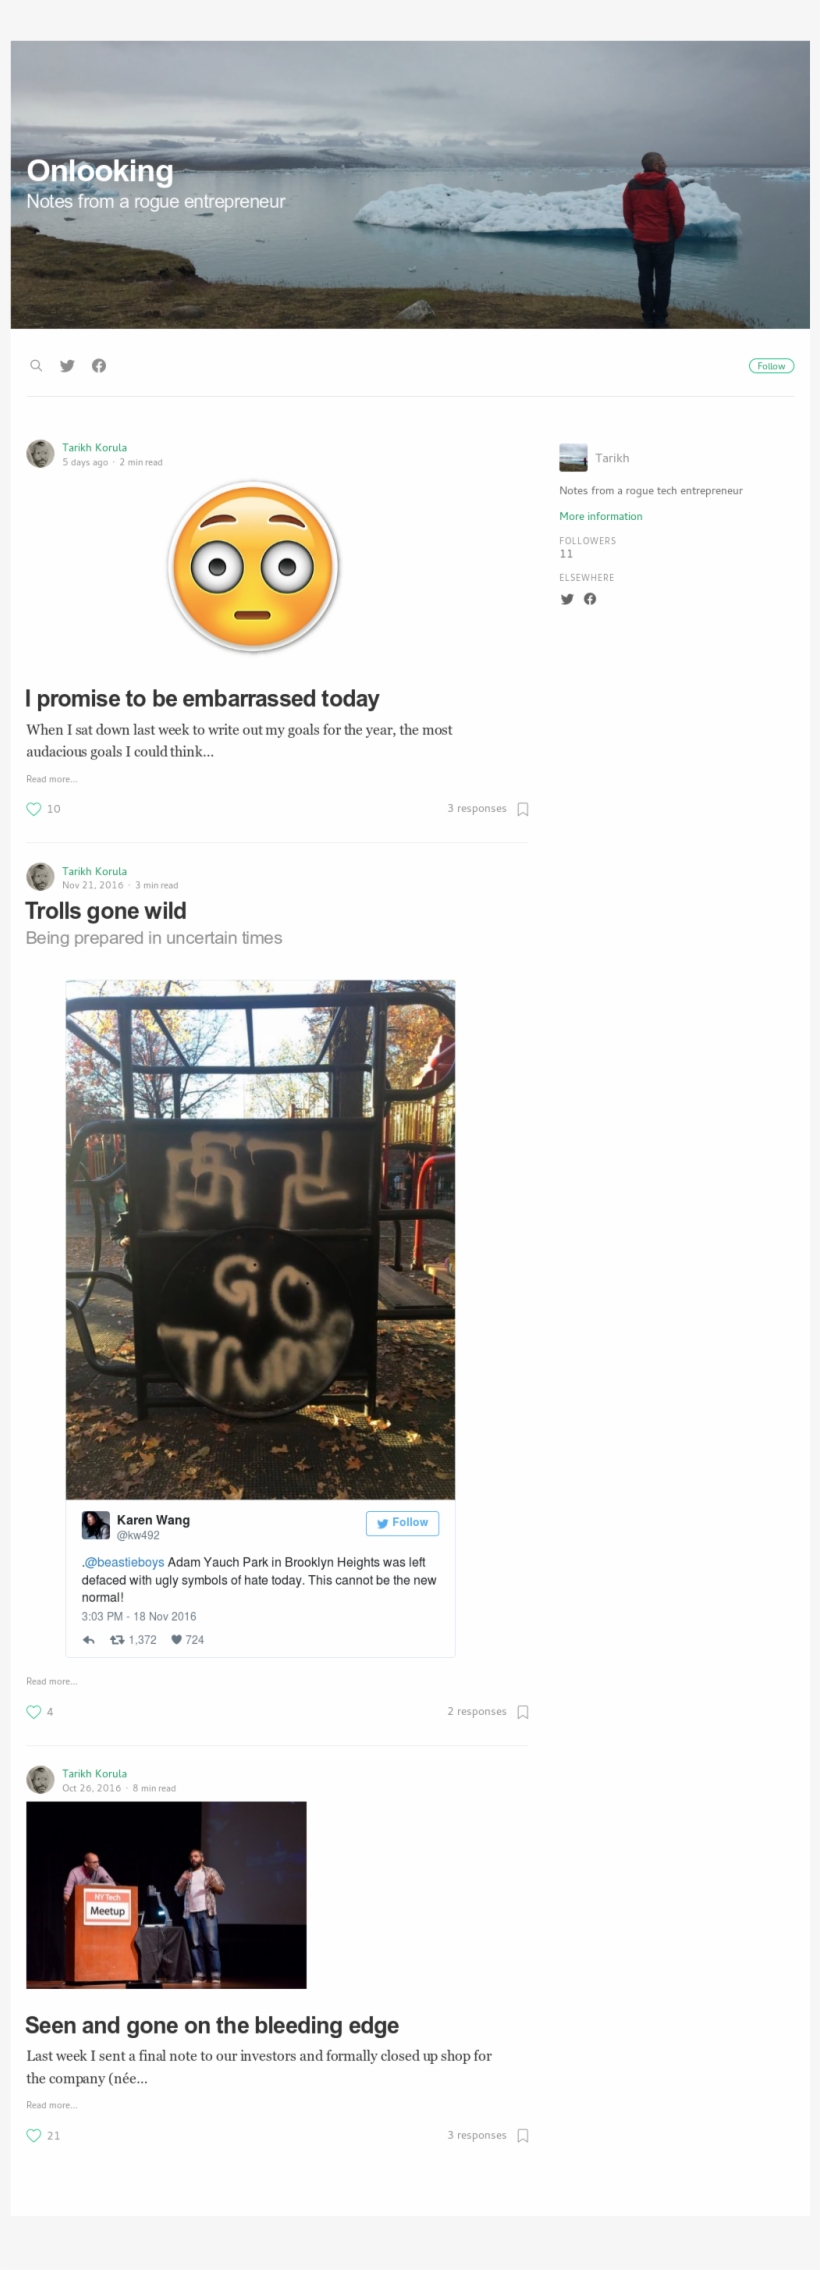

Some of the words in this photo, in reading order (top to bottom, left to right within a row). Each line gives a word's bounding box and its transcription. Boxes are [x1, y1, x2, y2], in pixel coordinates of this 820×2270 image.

[27, 159, 174, 188] Onlooking
[28, 194, 72, 208] Notes
[78, 194, 113, 208] from
[120, 198, 128, 208] a
[135, 198, 179, 212] rogue
[185, 195, 285, 211] entrepreneur
[757, 362, 786, 370] Follow
[62, 443, 92, 452] Tarikh
[95, 443, 127, 452] Korula
[595, 453, 629, 462] Tarikh
[63, 458, 68, 466] 5
[71, 459, 90, 468] days
[120, 458, 124, 466] 2
[560, 486, 588, 495] Notes
[592, 486, 614, 495] from
[626, 489, 654, 498] rogue
[657, 486, 677, 495] tech
[681, 487, 743, 498] entrepreneur
[560, 512, 585, 520] More
[588, 512, 643, 520] information
[561, 549, 572, 558] 11
[26, 689, 30, 707] I
[38, 689, 120, 712] promise
[125, 690, 146, 707] to
[153, 689, 177, 707] be
[183, 689, 316, 707] embarrassed
[321, 689, 380, 712] today
[26, 723, 63, 735] When
[67, 724, 72, 735] I
[75, 725, 93, 735] sat
[96, 723, 130, 735] down
[133, 723, 155, 735] last
[158, 723, 190, 735] week
[193, 725, 205, 735] to
[208, 723, 239, 735] write
[242, 725, 263, 735] out
[266, 727, 285, 738] my
[288, 723, 319, 738] goals
[323, 723, 341, 735] for
[344, 723, 362, 735] the
[366, 727, 396, 738] year,
[399, 723, 419, 735] the
[422, 725, 453, 735] most
[27, 745, 87, 757] audacious
[90, 745, 122, 760] goals
[126, 746, 131, 757] I
[134, 745, 168, 757] could
[170, 745, 213, 757] think...
[48, 805, 60, 813] 10
[448, 804, 453, 812] 3
[458, 806, 506, 815] responses
[62, 867, 92, 876] Tarikh
[95, 867, 127, 876] Korula
[63, 881, 79, 889] Nov
[83, 881, 97, 890] 21,
[100, 881, 123, 889] 2016
[136, 881, 140, 889] 3
[25, 901, 81, 919] Trolls
[87, 906, 139, 924] gone
[144, 901, 186, 919] wild
[27, 931, 69, 947] Being
[75, 931, 143, 947] prepared
[149, 931, 161, 944] in
[167, 931, 237, 944] uncertain
[242, 931, 282, 944] times
[213, 1254, 321, 1331] GO
[117, 1515, 152, 1525] Karen
[156, 1515, 190, 1528] Wang
[393, 1517, 428, 1526] Follow
[117, 1530, 159, 1541] @kw492
[82, 1557, 165, 1570] .@beastieboys
[168, 1557, 200, 1567] Adam
[203, 1557, 239, 1567] Yauch
[243, 1557, 269, 1567] Park
[272, 1557, 281, 1567] in
[285, 1557, 333, 1570] Brooklyn
[337, 1557, 380, 1570] Heights
[383, 1559, 406, 1567] was
[409, 1557, 426, 1567] left
[82, 1575, 126, 1585] defaced
[129, 1575, 152, 1585] with
[156, 1575, 179, 1588] ugly
[182, 1575, 228, 1588] symbols
[231, 1575, 241, 1585] of
[245, 1575, 268, 1585] hate
[271, 1575, 305, 1588] today.
[308, 1575, 332, 1585] This
[335, 1575, 373, 1585] cannot
[376, 1575, 390, 1585] be
[393, 1575, 410, 1585] the
[414, 1577, 437, 1585] new
[82, 1592, 123, 1602] normal!
[82, 1612, 103, 1621] 3:03
[107, 1612, 123, 1621] PM
[134, 1612, 145, 1621] 18
[149, 1612, 168, 1621] Nov
[172, 1612, 196, 1621] 2016
[130, 1635, 156, 1645] 1,372
[186, 1635, 204, 1644] 724
[27, 1677, 46, 1685] Read
[47, 1708, 53, 1716] 4
[448, 1707, 453, 1715] 2
[458, 1709, 506, 1718] responses
[62, 1769, 92, 1778] Tarikh
[95, 1769, 127, 1778] Korula
[63, 1784, 76, 1792] Oct
[80, 1784, 94, 1792] 26,
[98, 1784, 121, 1792] 2016
[133, 1784, 138, 1792] 8
[94, 1893, 104, 1901] NY
[105, 1893, 121, 1901] Tech
[90, 1906, 125, 1917] Meetup
[25, 2016, 76, 2034] Seen
[82, 2016, 120, 2034] and
[127, 2020, 178, 2038] gone
[184, 2020, 210, 2034] on
[216, 2016, 249, 2034] the
[255, 2016, 342, 2038] bleeding
[349, 2016, 399, 2038] edge
[27, 2050, 53, 2061] Last
[56, 2049, 87, 2061] week
[91, 2050, 95, 2061] I
[99, 2051, 126, 2061] sent
[129, 2053, 136, 2061] a
[139, 2049, 166, 2061] final
[170, 2051, 197, 2061] note
[200, 2051, 213, 2061] to
[216, 2053, 238, 2061] our
[240, 2049, 296, 2061] investors
[300, 2049, 323, 2061] and
[326, 2049, 378, 2064] formally
[381, 2049, 420, 2061] closed
[423, 2053, 438, 2064] up
[441, 2049, 471, 2064] shop
[474, 2049, 492, 2061] for
[26, 2072, 46, 2084] the
[49, 2076, 106, 2087] company
[109, 2072, 147, 2086] (née...
[27, 2101, 46, 2109] Read
[48, 2132, 59, 2140] 21
[448, 2131, 453, 2139] 3
[458, 2133, 506, 2142] responses
